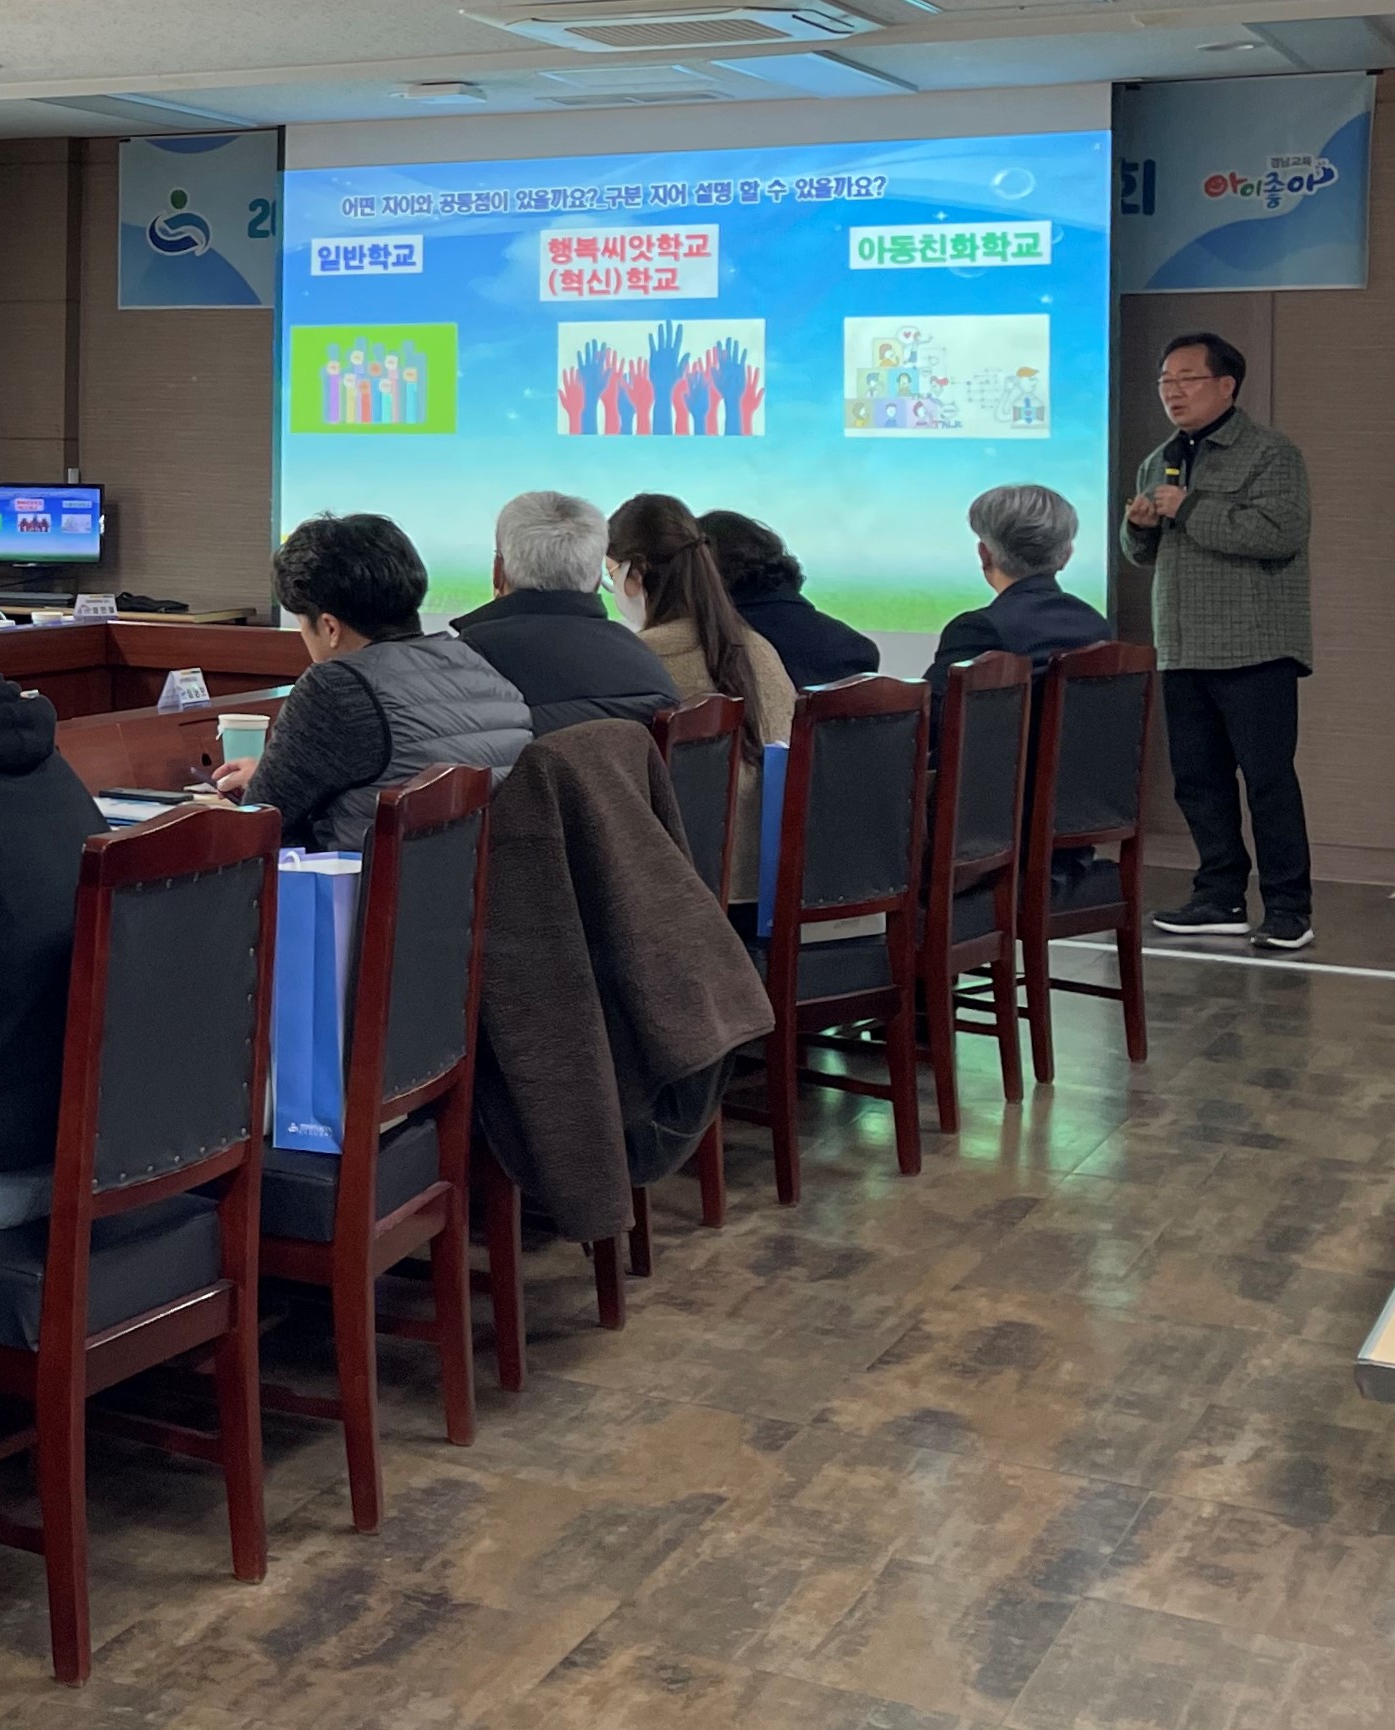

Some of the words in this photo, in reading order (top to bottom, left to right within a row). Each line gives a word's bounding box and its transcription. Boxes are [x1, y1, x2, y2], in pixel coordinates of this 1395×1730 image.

[1270, 156, 1313, 169] 경남교육
[342, 196, 375, 216] 어떤
[439, 190, 509, 213] 공통점이
[605, 184, 641, 208] 구분
[650, 183, 687, 206] 지어
[695, 181, 732, 204] 설명
[739, 180, 760, 202] 할
[767, 179, 787, 201] 수
[795, 175, 887, 200] 있을까요?
[1203, 162, 1335, 209] 아이좋아
[317, 243, 417, 272] 일반학교
[548, 233, 712, 264] 행복씨앗학교
[857, 231, 1044, 265] 아동친화학교
[548, 267, 681, 297] (혁신)학교
